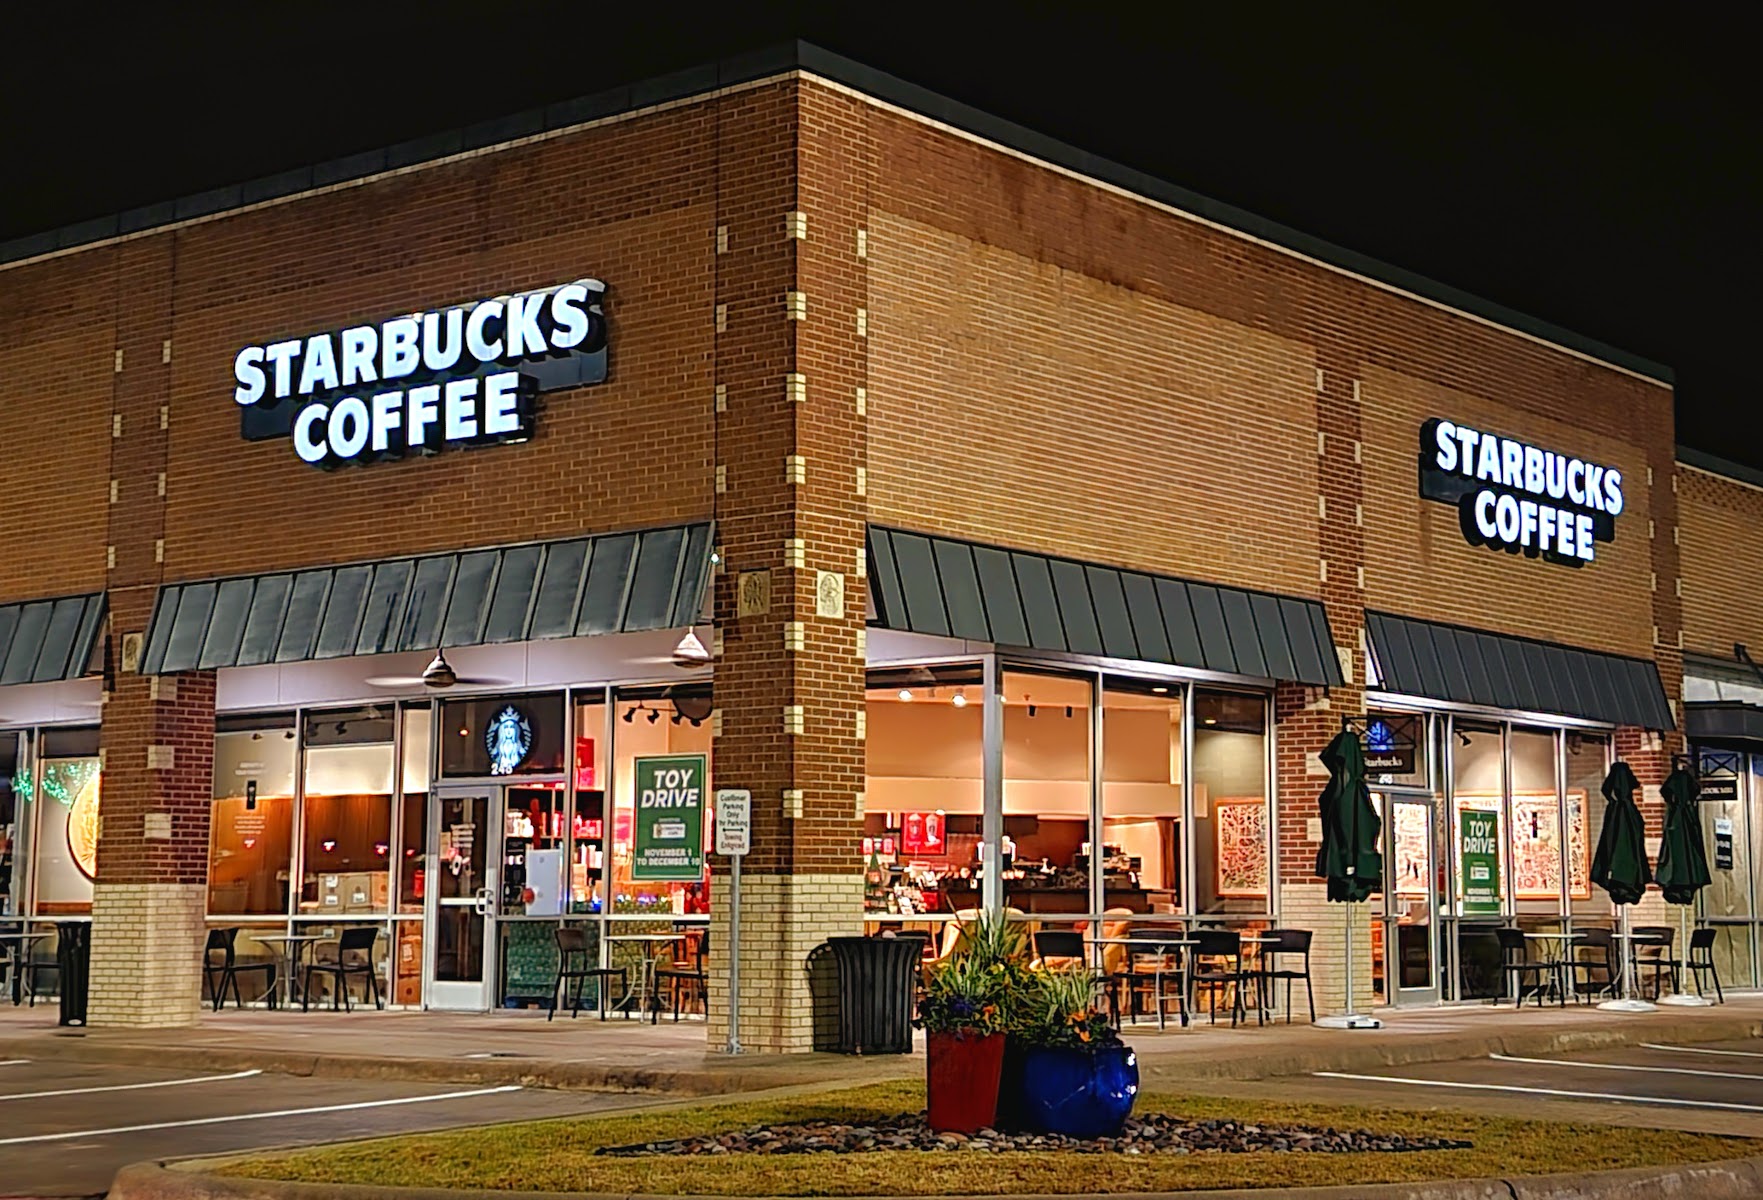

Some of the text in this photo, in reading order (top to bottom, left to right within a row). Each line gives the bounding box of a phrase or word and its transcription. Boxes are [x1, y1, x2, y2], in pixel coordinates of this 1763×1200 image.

[233, 282, 590, 406] STARBUCKS
[293, 371, 521, 463] COFFEE
[1436, 420, 1625, 516] STARBUCKS
[1474, 489, 1595, 562] COFFEE
[654, 769, 693, 788] TOY
[641, 788, 698, 808] DRIVE
[720, 794, 747, 802] Customer
[722, 802, 744, 811] Parking
[726, 811, 739, 819] Only
[727, 819, 748, 827] Parking
[1469, 821, 1492, 837] TOY
[724, 833, 743, 842] Towing
[1464, 837, 1495, 853] DRIVE
[644, 848, 692, 857] NOVEMBER 1
[636, 857, 648, 866] TO
[648, 857, 690, 866] DECEMBER
